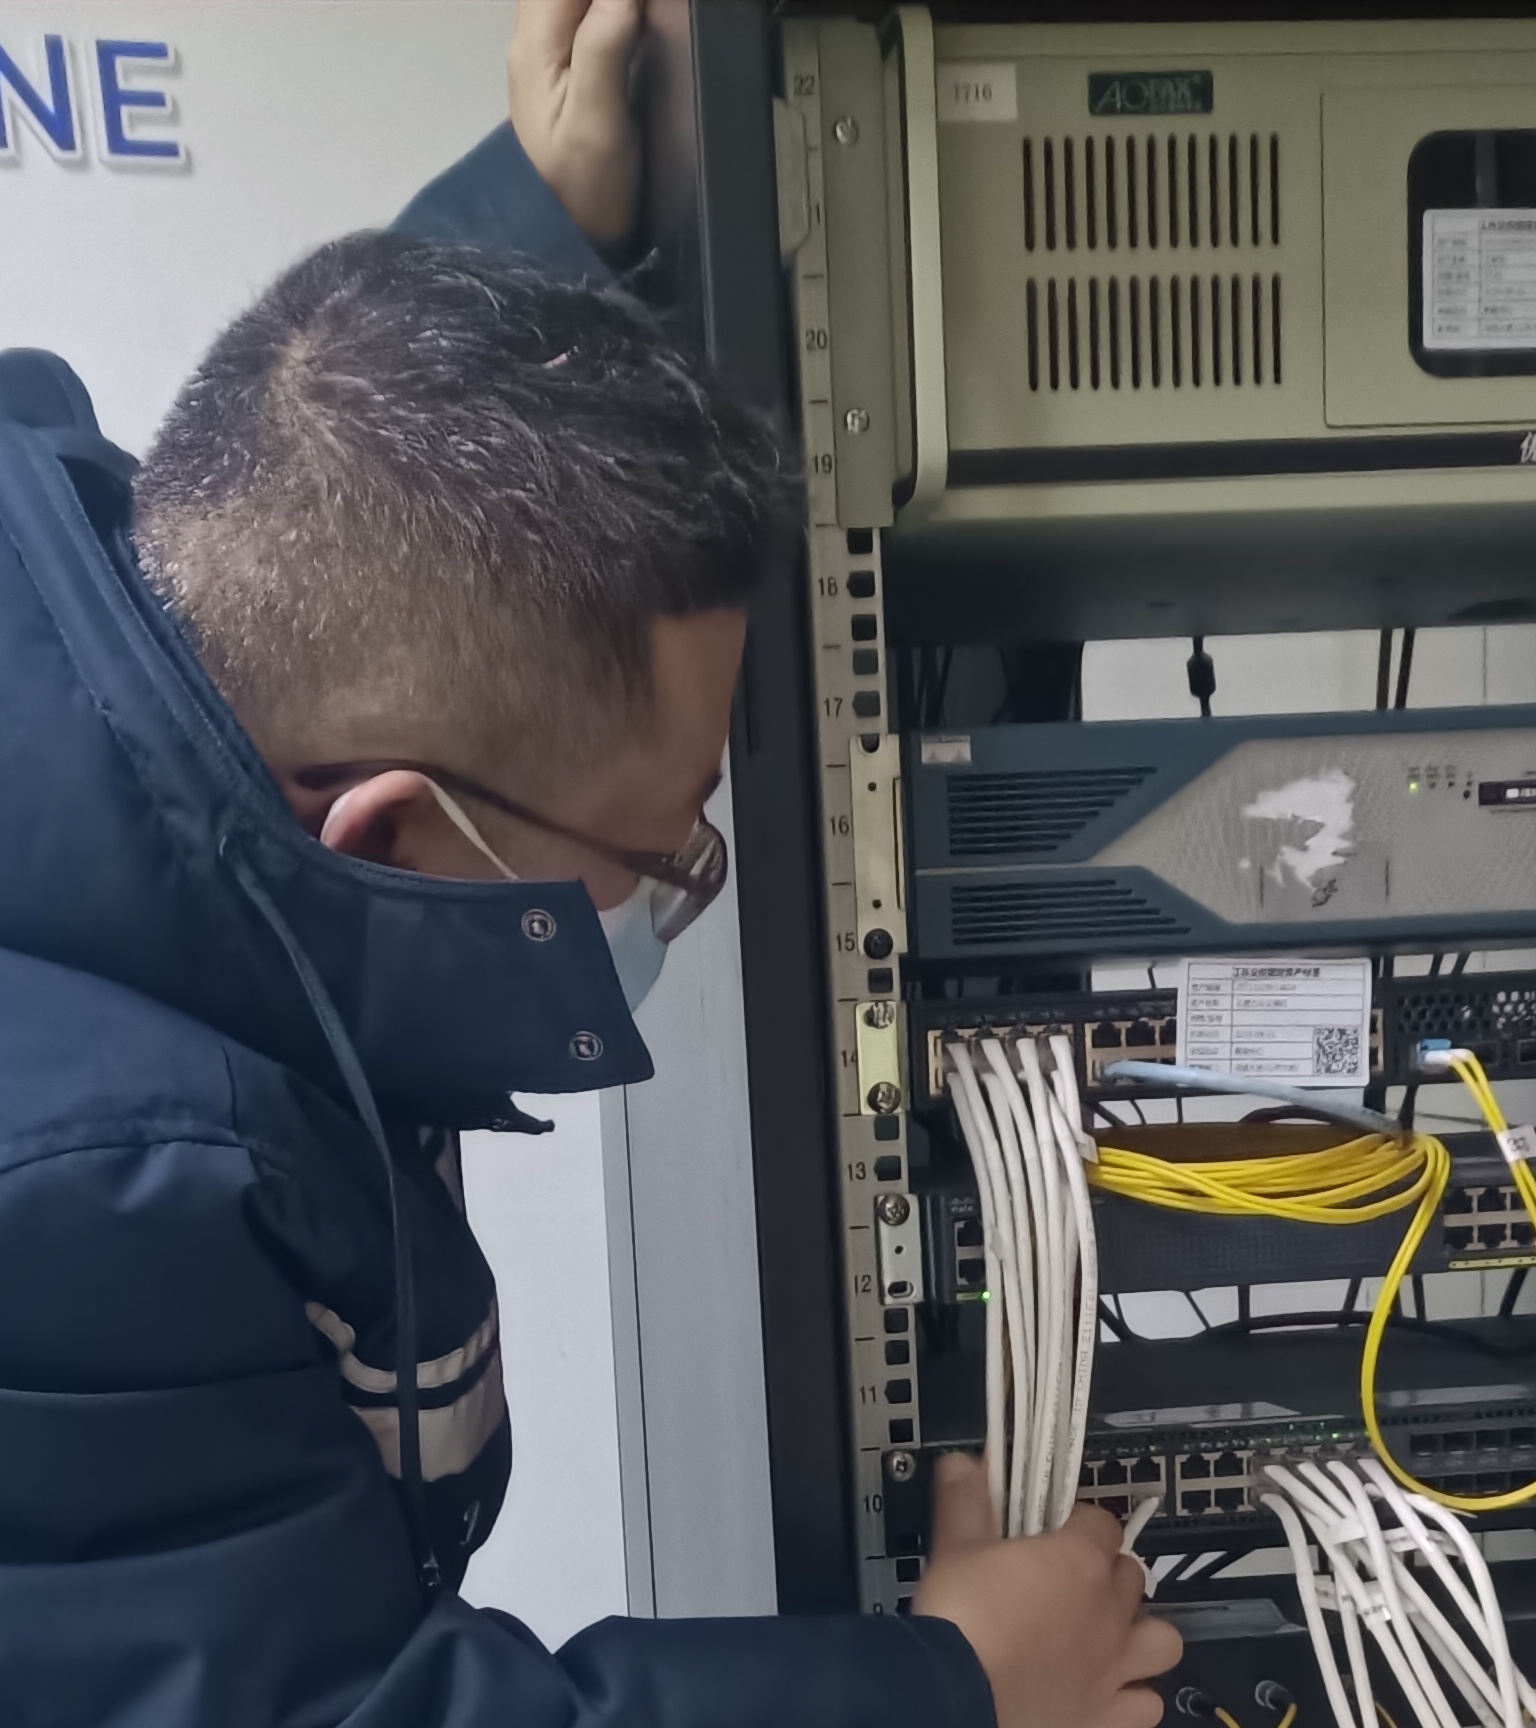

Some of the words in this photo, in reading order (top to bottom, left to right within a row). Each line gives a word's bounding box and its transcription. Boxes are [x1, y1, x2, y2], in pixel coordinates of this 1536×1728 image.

[806, 329, 828, 351] 20
[812, 453, 833, 474] 19
[818, 577, 838, 596] 18
[824, 698, 843, 717] 17
[830, 816, 850, 835] 16
[836, 933, 856, 952] 15
[847, 1163, 866, 1181] 13
[853, 1275, 872, 1293] 12
[859, 1386, 878, 1404] 11
[864, 1495, 883, 1513] 10
